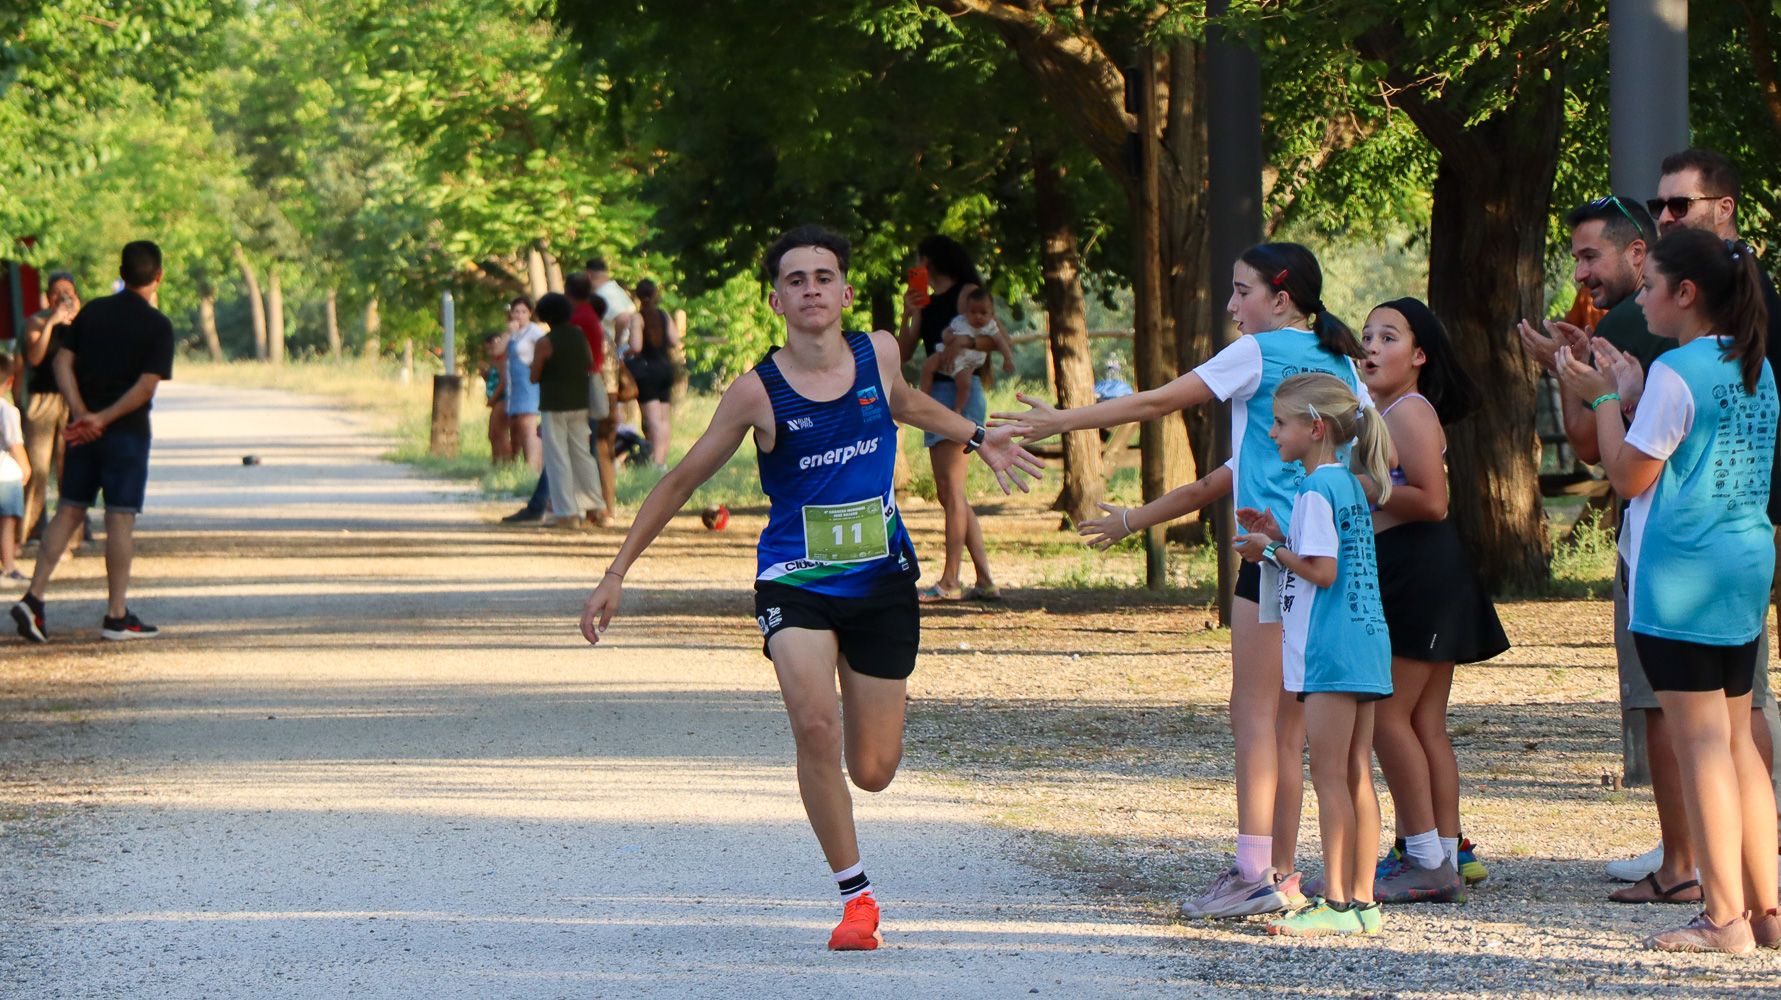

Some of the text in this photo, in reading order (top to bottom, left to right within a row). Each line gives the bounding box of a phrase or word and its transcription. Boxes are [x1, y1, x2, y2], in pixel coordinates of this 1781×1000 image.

[797, 416, 811, 424] RUN
[800, 421, 814, 430] PRO
[799, 437, 879, 470] enerplus
[832, 522, 862, 545] 11
